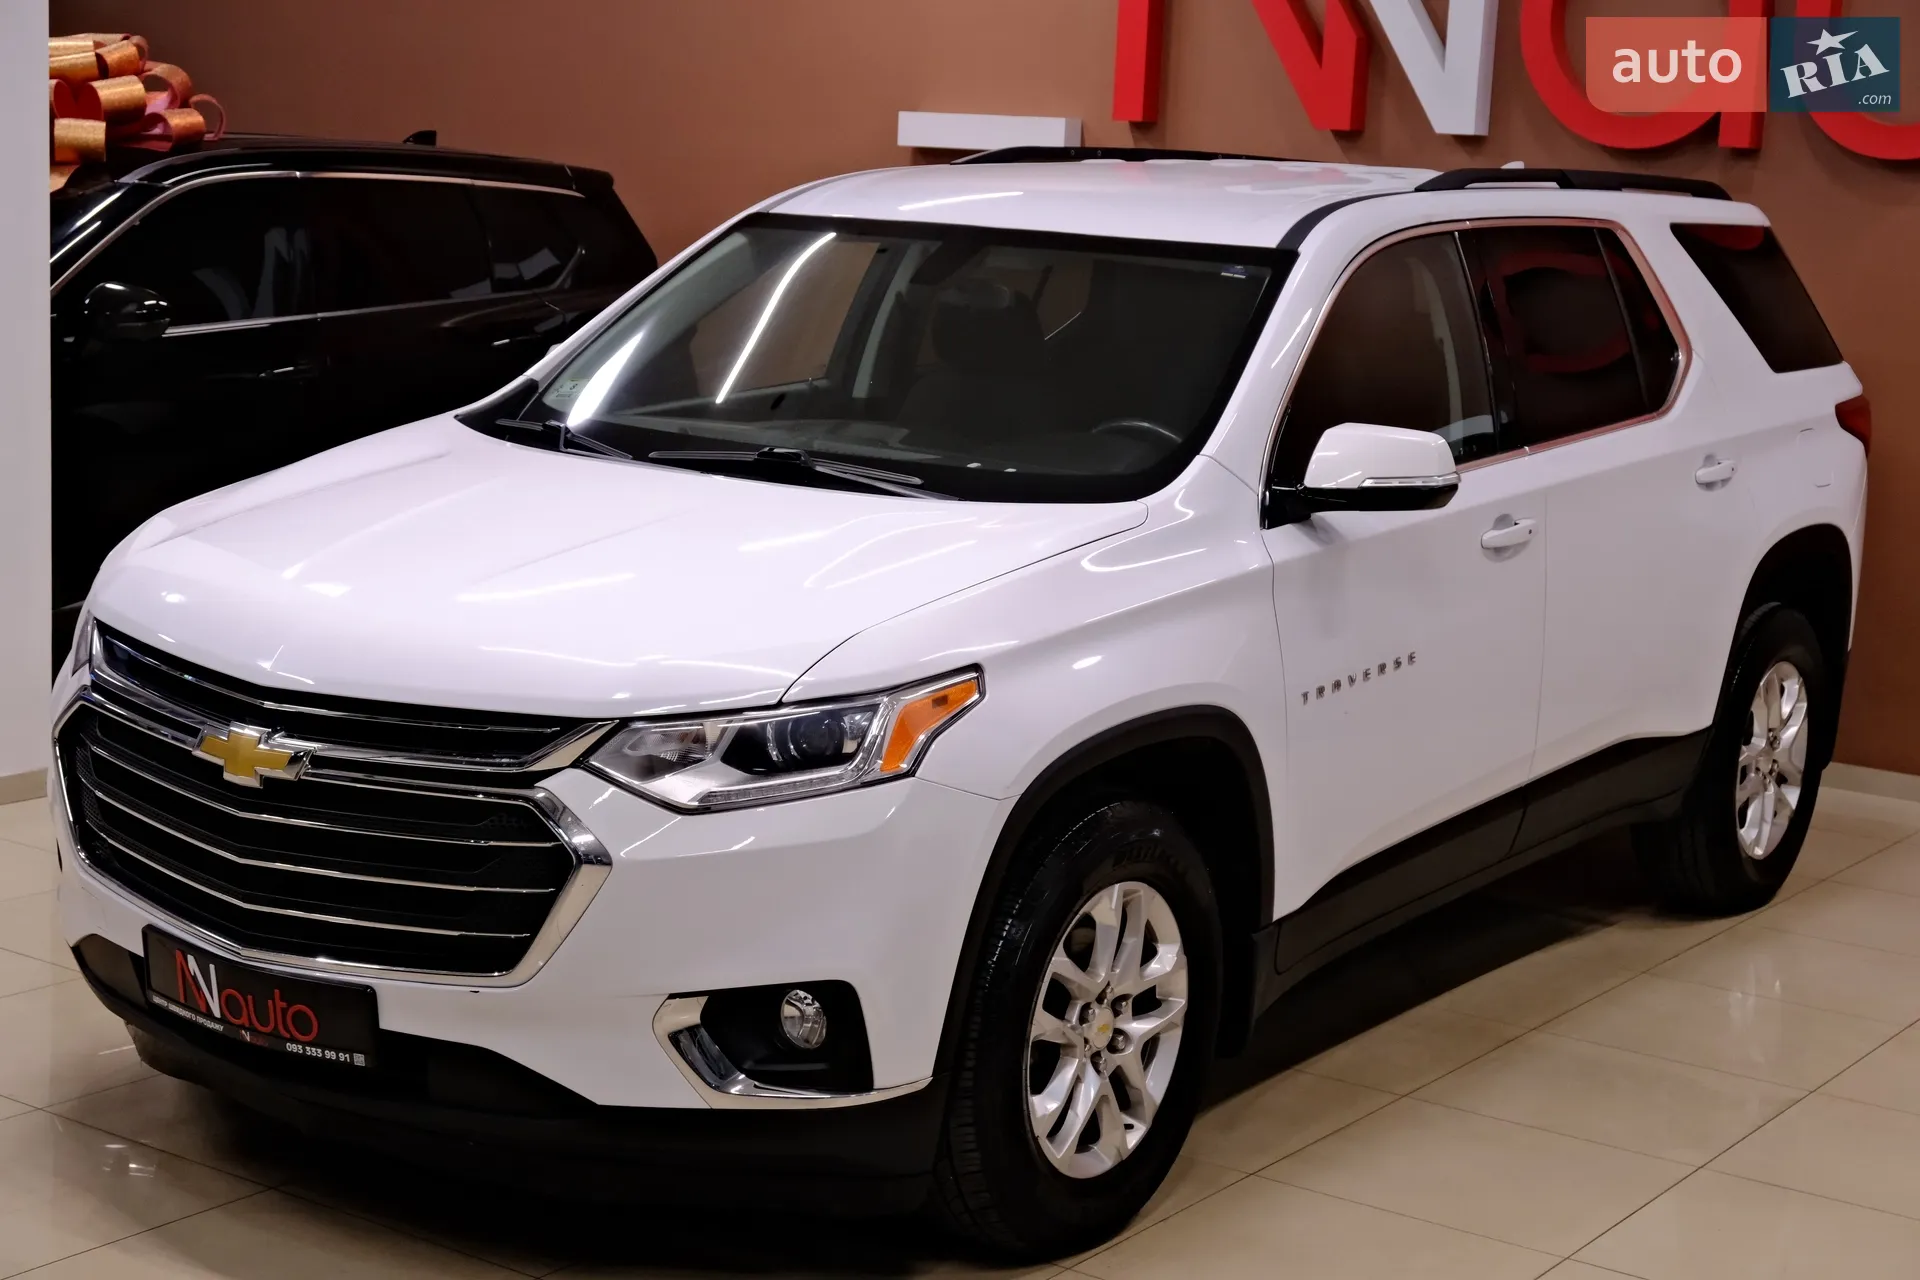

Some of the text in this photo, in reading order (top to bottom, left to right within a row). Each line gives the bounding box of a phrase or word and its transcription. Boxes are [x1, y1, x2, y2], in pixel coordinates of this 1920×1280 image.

[1301, 651, 1416, 705] TRAVERSE
[286, 1042, 350, 1062] 093 333 99 91
